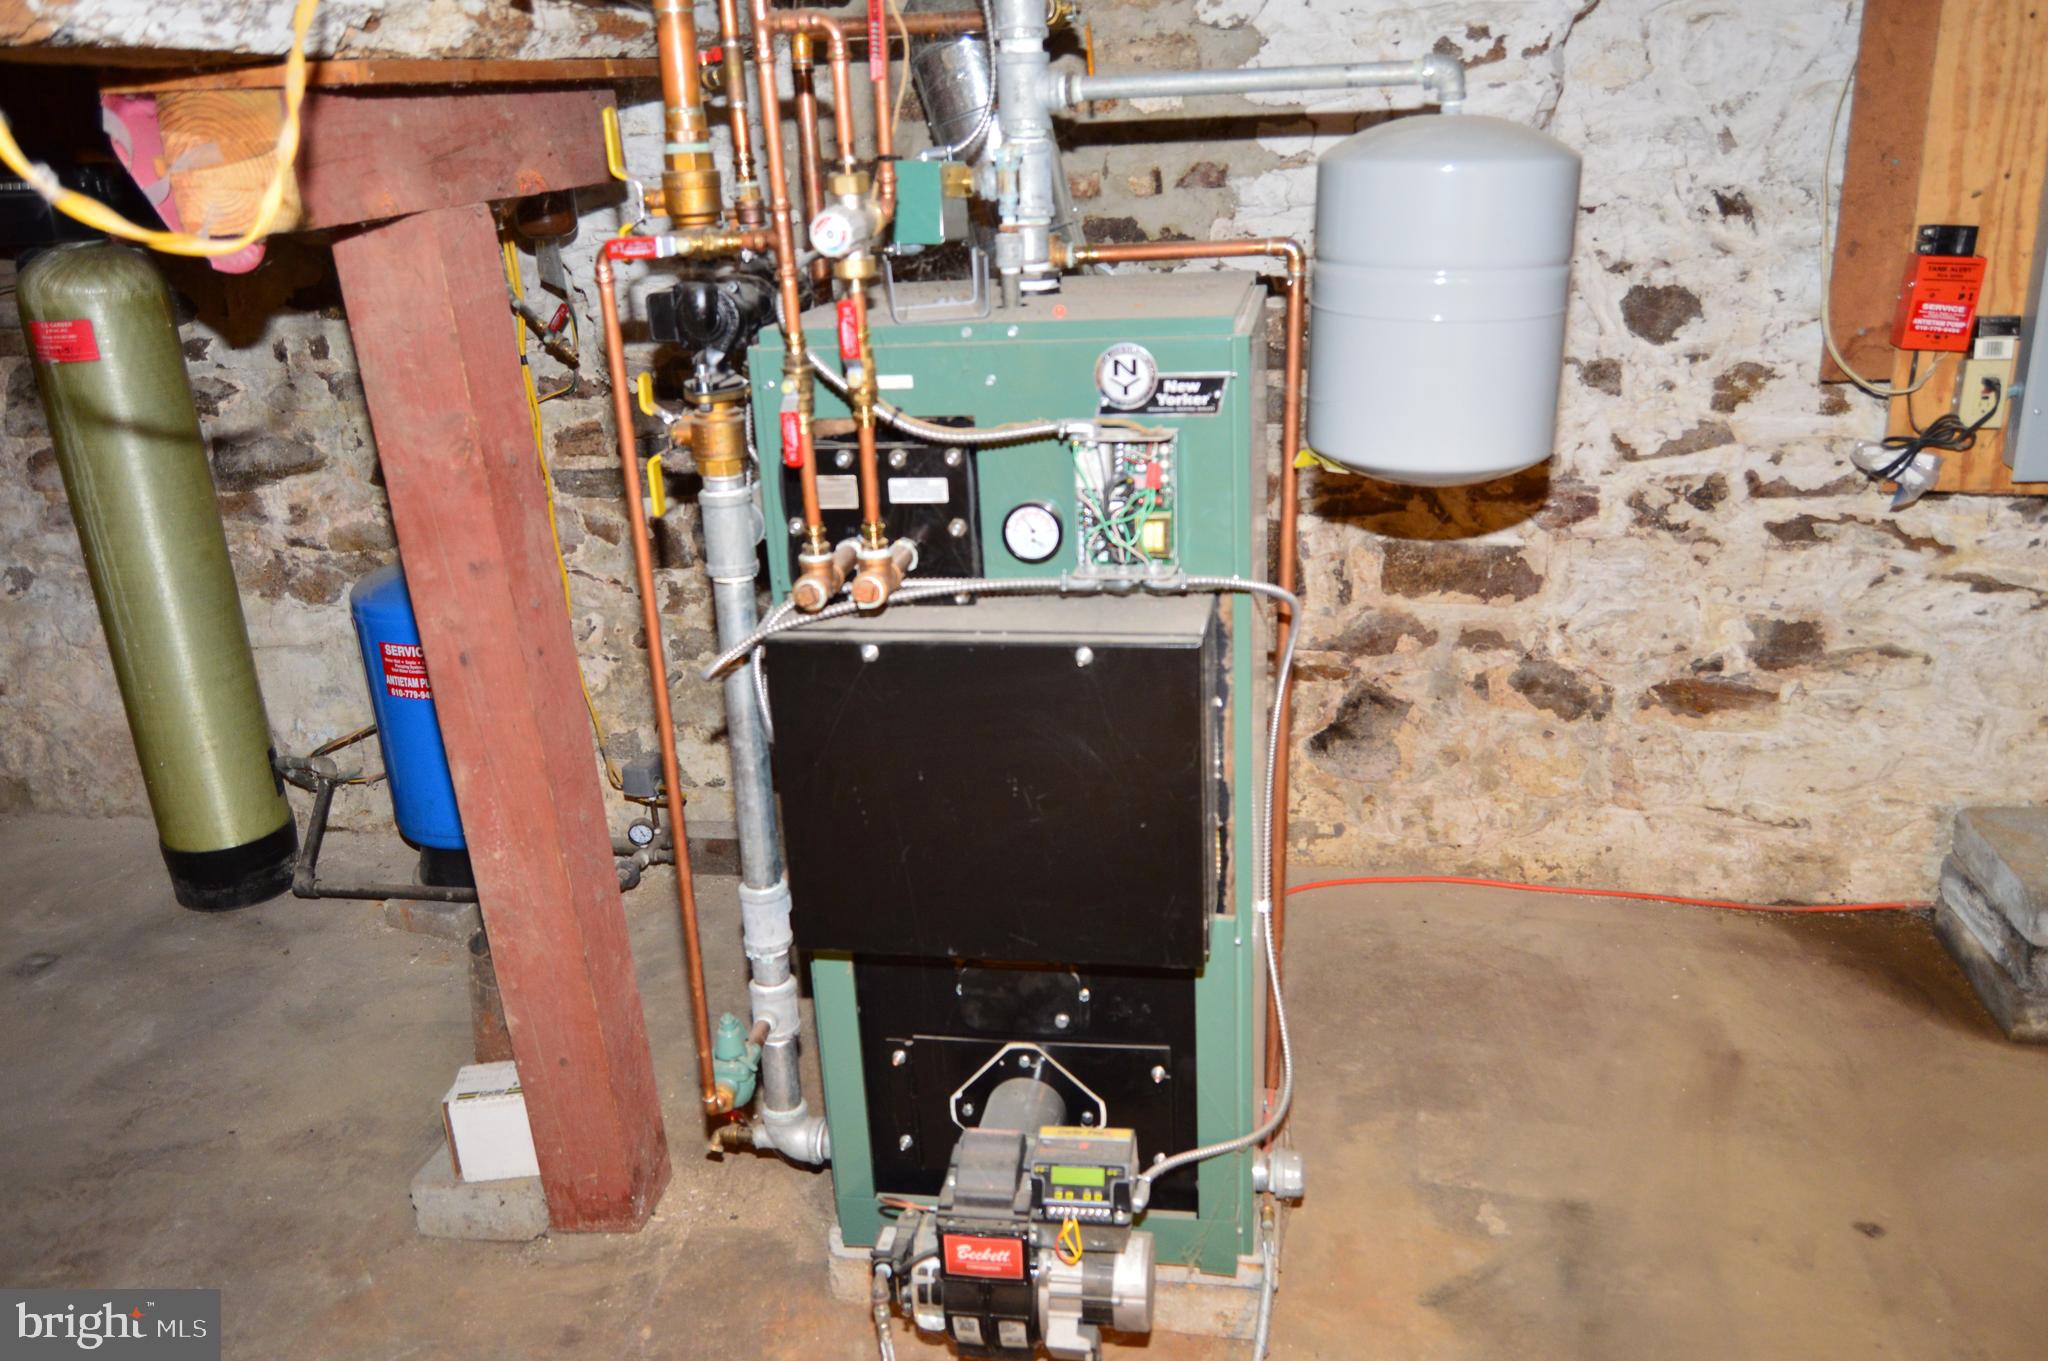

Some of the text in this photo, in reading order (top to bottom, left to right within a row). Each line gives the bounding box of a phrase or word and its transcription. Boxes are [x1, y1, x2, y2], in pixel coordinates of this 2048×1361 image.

[1922, 303, 1966, 313] SERVICE
[1163, 380, 1201, 393] New
[1155, 393, 1209, 406] Yorker
[385, 644, 424, 657] SERVIC
[386, 674, 431, 688] ANTIETAM PU
[957, 1244, 1011, 1262] Beckett
